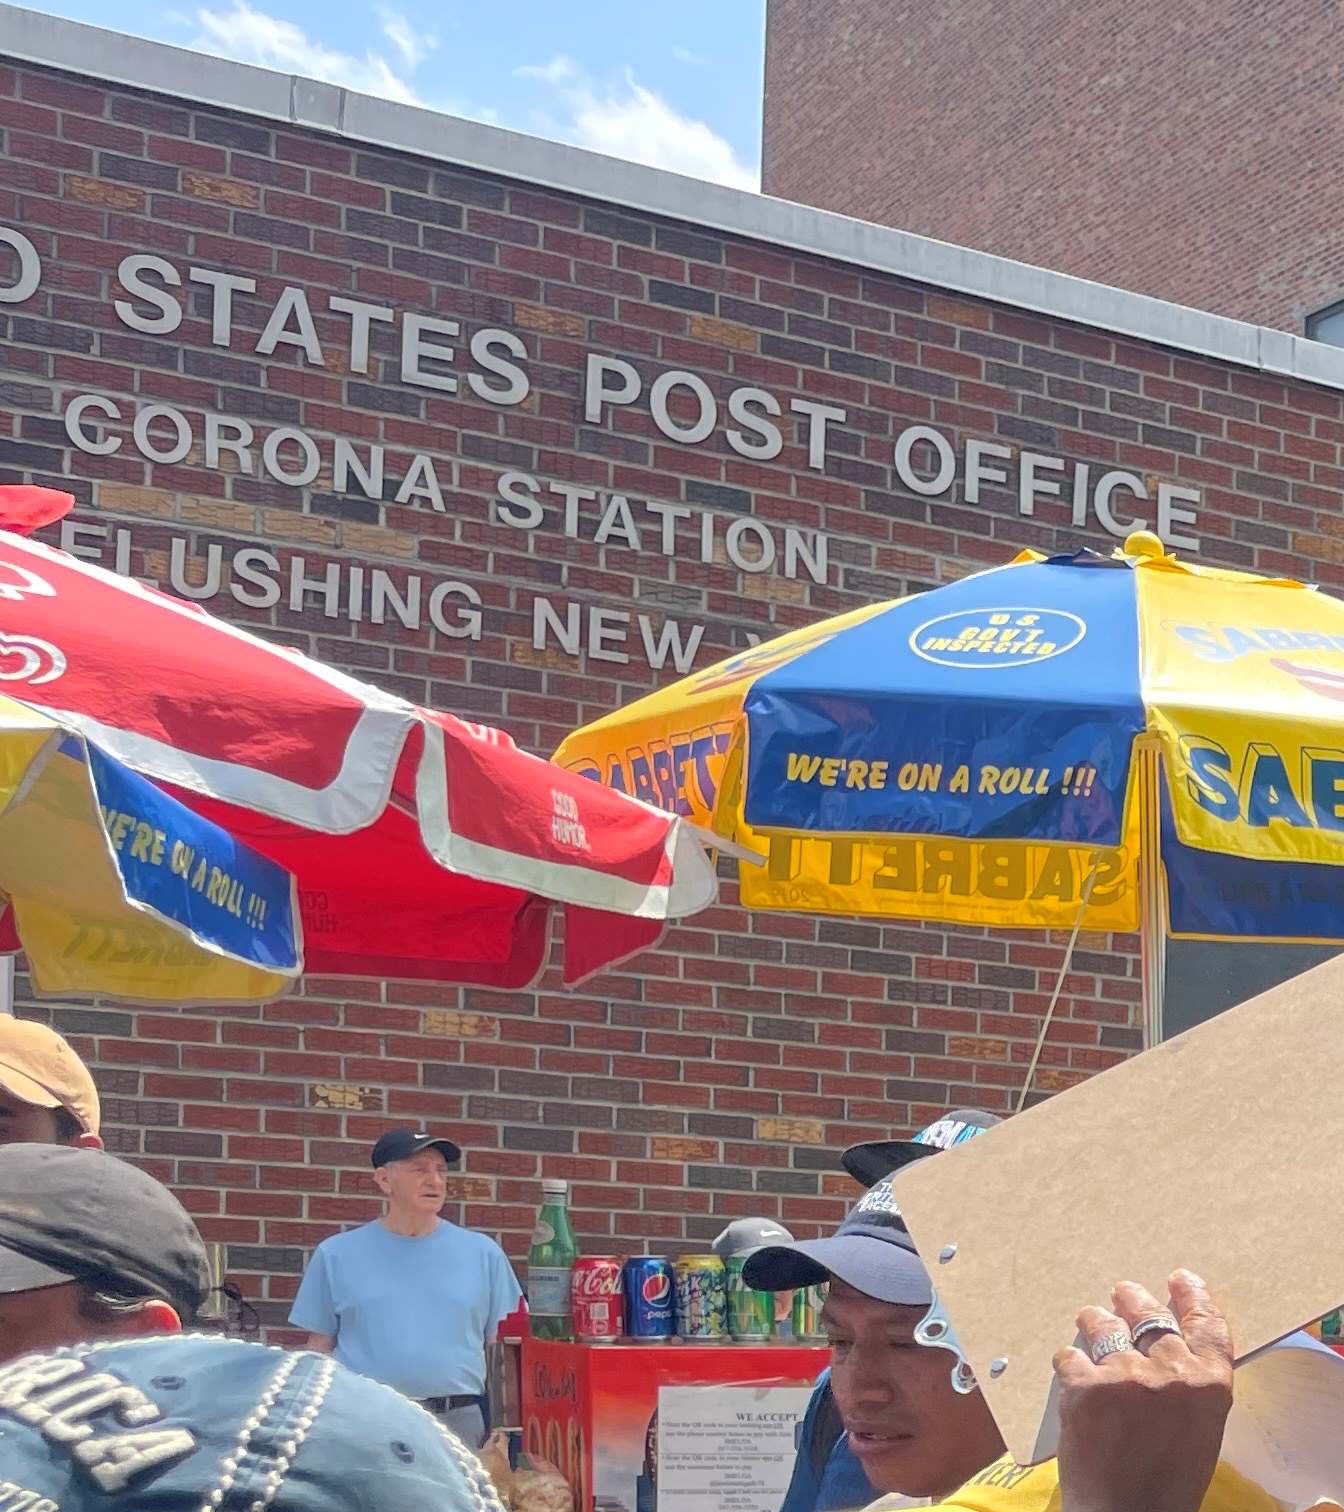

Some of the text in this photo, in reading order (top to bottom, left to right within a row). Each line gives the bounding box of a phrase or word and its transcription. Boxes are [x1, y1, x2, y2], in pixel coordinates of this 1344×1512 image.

[114, 254, 530, 405] STATES
[585, 354, 847, 470] POST
[895, 426, 1201, 551] OFFICE
[64, 394, 828, 585] CORONA STATION
[60, 520, 704, 675] FLUSHING NEW
[921, 637, 1057, 656] INSPECTED
[786, 752, 1098, 798] WE'RE ON A ROLL !!!
[191, 857, 208, 893] A
[206, 876, 245, 919] ROLL
[735, 1412, 800, 1422] WE ACCEPT
